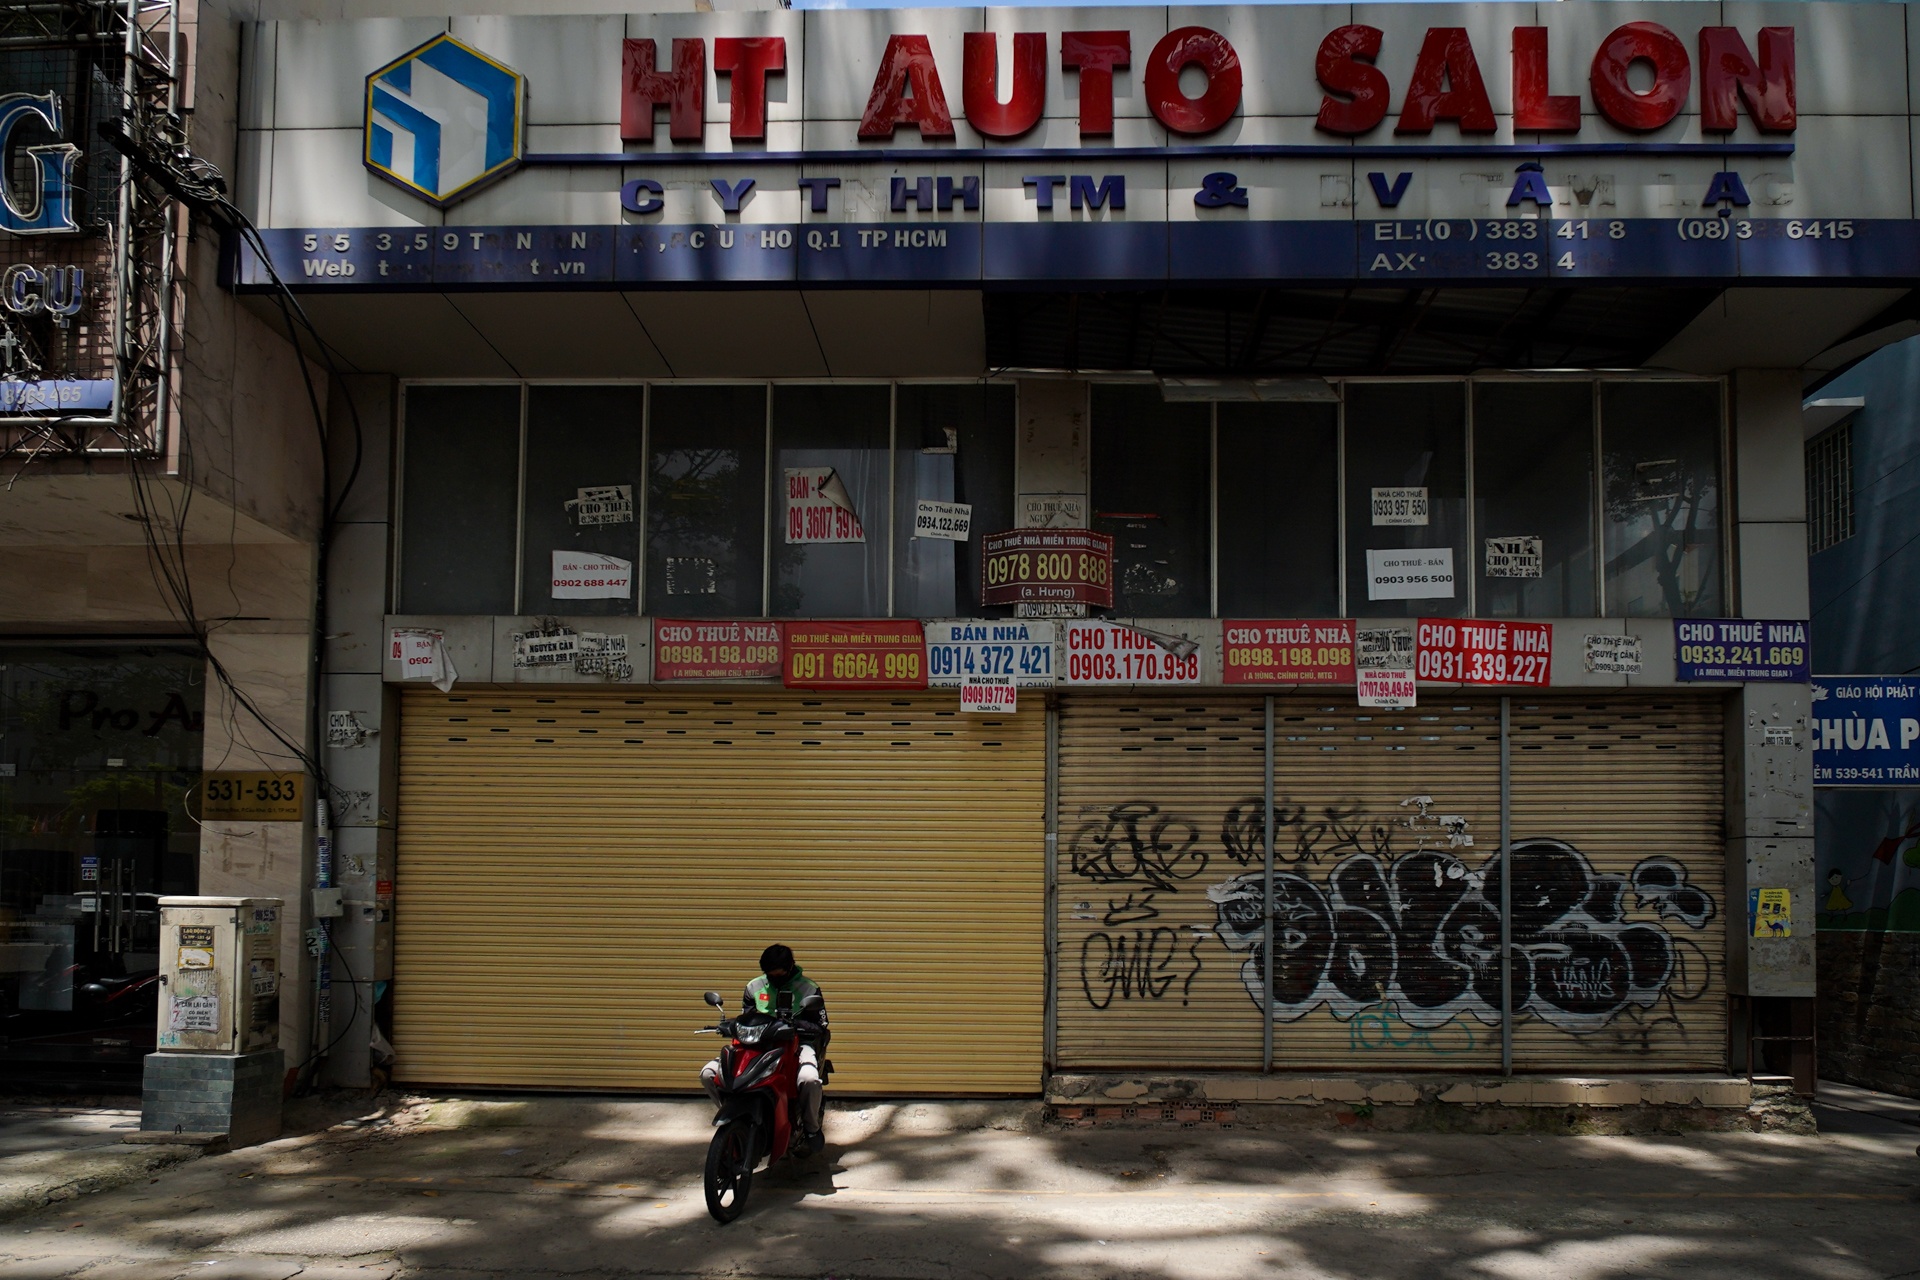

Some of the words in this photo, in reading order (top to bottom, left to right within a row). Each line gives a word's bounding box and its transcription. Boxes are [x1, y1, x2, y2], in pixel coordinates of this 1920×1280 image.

[620, 36, 787, 141] HT
[857, 26, 1243, 141] AUTO
[1314, 21, 1797, 136] SALON
[1023, 174, 1125, 210] TM
[1194, 172, 1249, 208] &
[807, 230, 841, 251] Q.1
[858, 230, 888, 248] TP
[894, 230, 947, 248] HCM
[790, 472, 809, 499] BÁN
[919, 504, 933, 512] Cho
[1026, 503, 1042, 512] CHO
[1373, 499, 1393, 516] 0933
[1395, 499, 1410, 515] 957
[1412, 499, 1427, 515] 550
[789, 507, 803, 540] 09
[806, 506, 833, 539] 3607
[917, 515, 969, 532] 0934.122.669
[988, 537, 1004, 550] CHO
[1004, 535, 1022, 549] THUÊ
[1023, 534, 1041, 546] NHÀ
[1066, 536, 1092, 547] TRUNG
[1092, 539, 1108, 551] GIAN
[562, 563, 578, 571] BÁN
[988, 553, 1031, 585] 0978
[1036, 553, 1073, 581] 800
[1078, 553, 1107, 585] 888
[553, 579, 582, 587] 0902
[583, 579, 604, 587] 688
[606, 579, 628, 587] 447
[1375, 576, 1404, 584] 0903
[1407, 575, 1429, 583] 956
[1431, 574, 1453, 583] 500
[1021, 586, 1035, 599] (a.
[1039, 586, 1075, 599] Hưng)
[659, 626, 692, 643] CHO
[696, 622, 740, 643] THUÊ
[743, 622, 780, 643] NHÀ
[791, 634, 808, 643] CHO
[809, 633, 830, 643] THUÊ
[831, 633, 849, 643] NHÀ
[874, 634, 900, 644] TRUNG
[901, 635, 922, 644] GIAN
[951, 624, 987, 641] BÁN
[992, 622, 1030, 641] NHÀ
[1069, 628, 1104, 650] CHO
[1226, 627, 1262, 644] CHO
[1265, 623, 1311, 644] THUÊ
[1314, 623, 1352, 644] NHÀ
[1418, 623, 1456, 648] CHO
[1461, 624, 1507, 651] THUÊ
[1513, 625, 1550, 653] NHÀ
[1679, 623, 1714, 642] CHO
[1719, 621, 1763, 643] THUÊ
[1768, 622, 1806, 643] NHÀ
[660, 645, 779, 664] 0898.198.098
[930, 645, 975, 675] 0914
[980, 645, 1014, 675] 372
[1019, 644, 1051, 674] 421
[1228, 647, 1351, 667] 0898.198.098
[1681, 645, 1804, 665] 0933.241.669
[792, 653, 825, 679] 091
[833, 653, 879, 679] 6664
[885, 653, 920, 679] 999
[1069, 653, 1199, 680] 0903.170.958
[1365, 671, 1378, 679] NHÀ
[1378, 671, 1390, 679] CHO
[1391, 671, 1407, 679] THUÊ
[1419, 650, 1549, 683] 0931.339.227
[1747, 669, 1770, 677] TRUNG
[1770, 669, 1788, 677] GIAN
[969, 676, 981, 684] NHÀ
[981, 676, 994, 684] CHO
[994, 675, 1010, 684] THUÊ
[1360, 681, 1414, 697] 0707.99.49.69
[962, 685, 983, 704] 0909
[984, 686, 993, 704] 19
[993, 686, 1004, 704] 77
[1004, 687, 1015, 704] 29
[1835, 684, 1861, 698] GIÁO
[1864, 684, 1883, 700] HỘI
[1886, 683, 1915, 700] PHẬT
[60, 690, 138, 730] Pro
[330, 714, 344, 727] CHO
[1836, 767, 1883, 779] 539-541
[1887, 763, 1919, 779] TRẦN
[207, 779, 295, 801] 531-533
